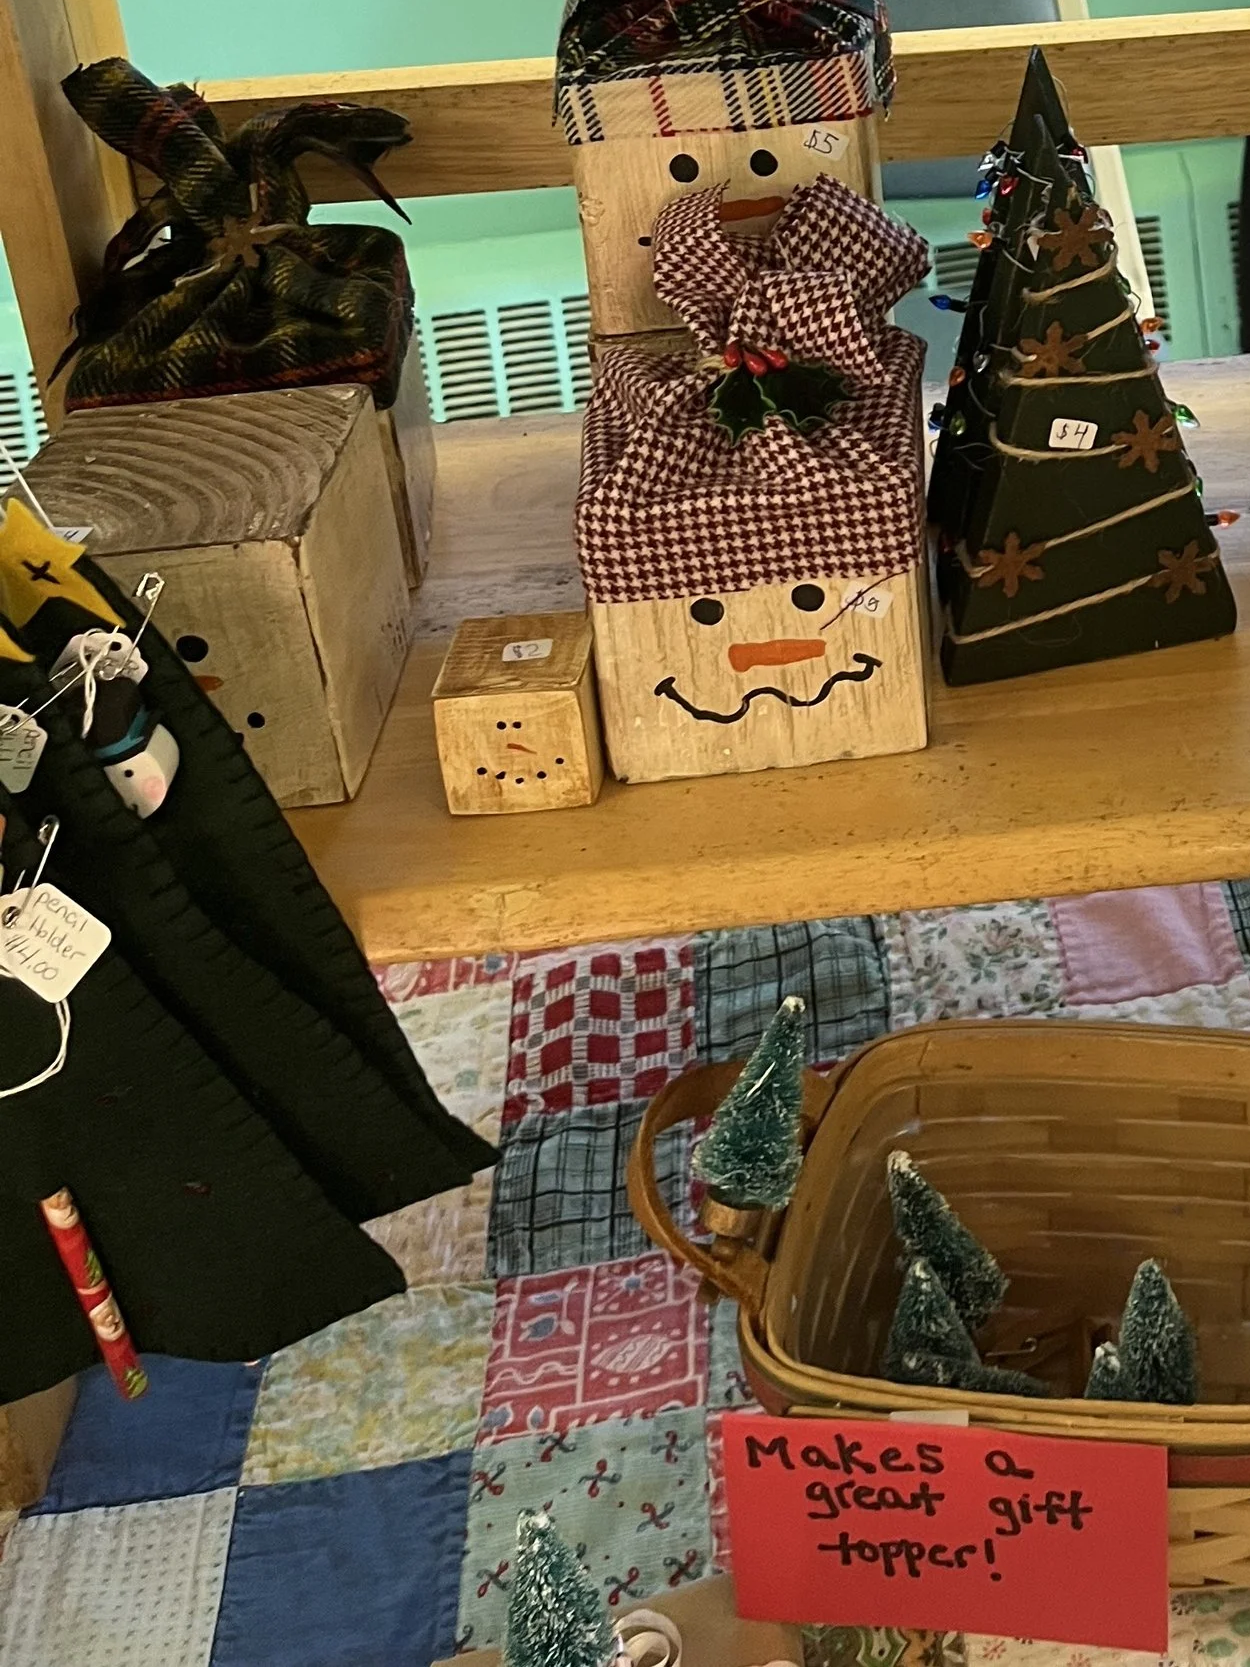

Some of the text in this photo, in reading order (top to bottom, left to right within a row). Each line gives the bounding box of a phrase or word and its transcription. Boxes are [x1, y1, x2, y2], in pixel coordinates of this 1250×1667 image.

[803, 128, 840, 154] $5
[1055, 423, 1090, 450] $4
[512, 643, 544, 659] $2
[744, 1433, 1035, 1480] Makes a
[805, 1479, 1093, 1536] great gift
[817, 1531, 1003, 1582] topper!
